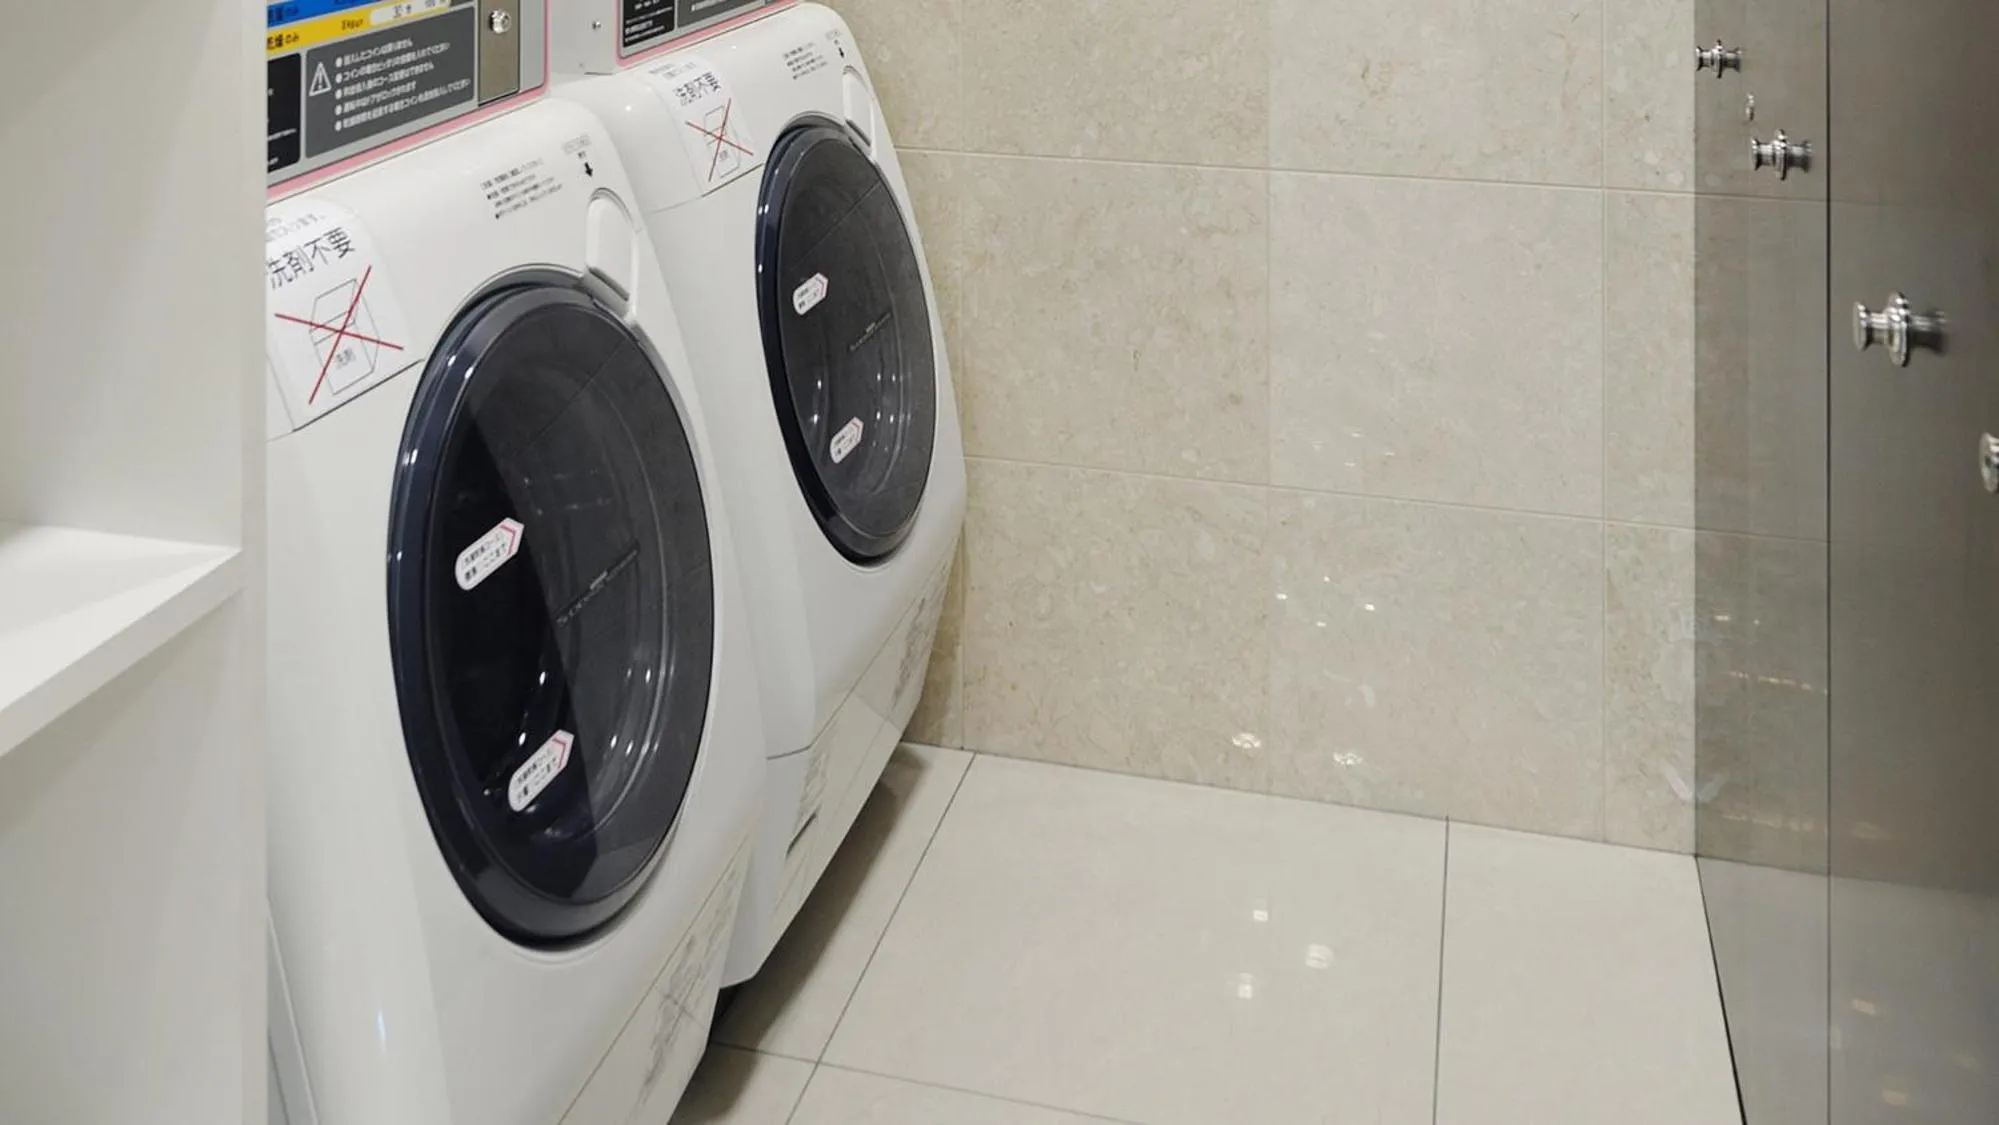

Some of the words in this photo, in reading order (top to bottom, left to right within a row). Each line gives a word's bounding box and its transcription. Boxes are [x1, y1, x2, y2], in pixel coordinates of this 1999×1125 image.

[672, 71, 722, 106] 洗剤不要
[266, 226, 356, 291] 洗剤不要
